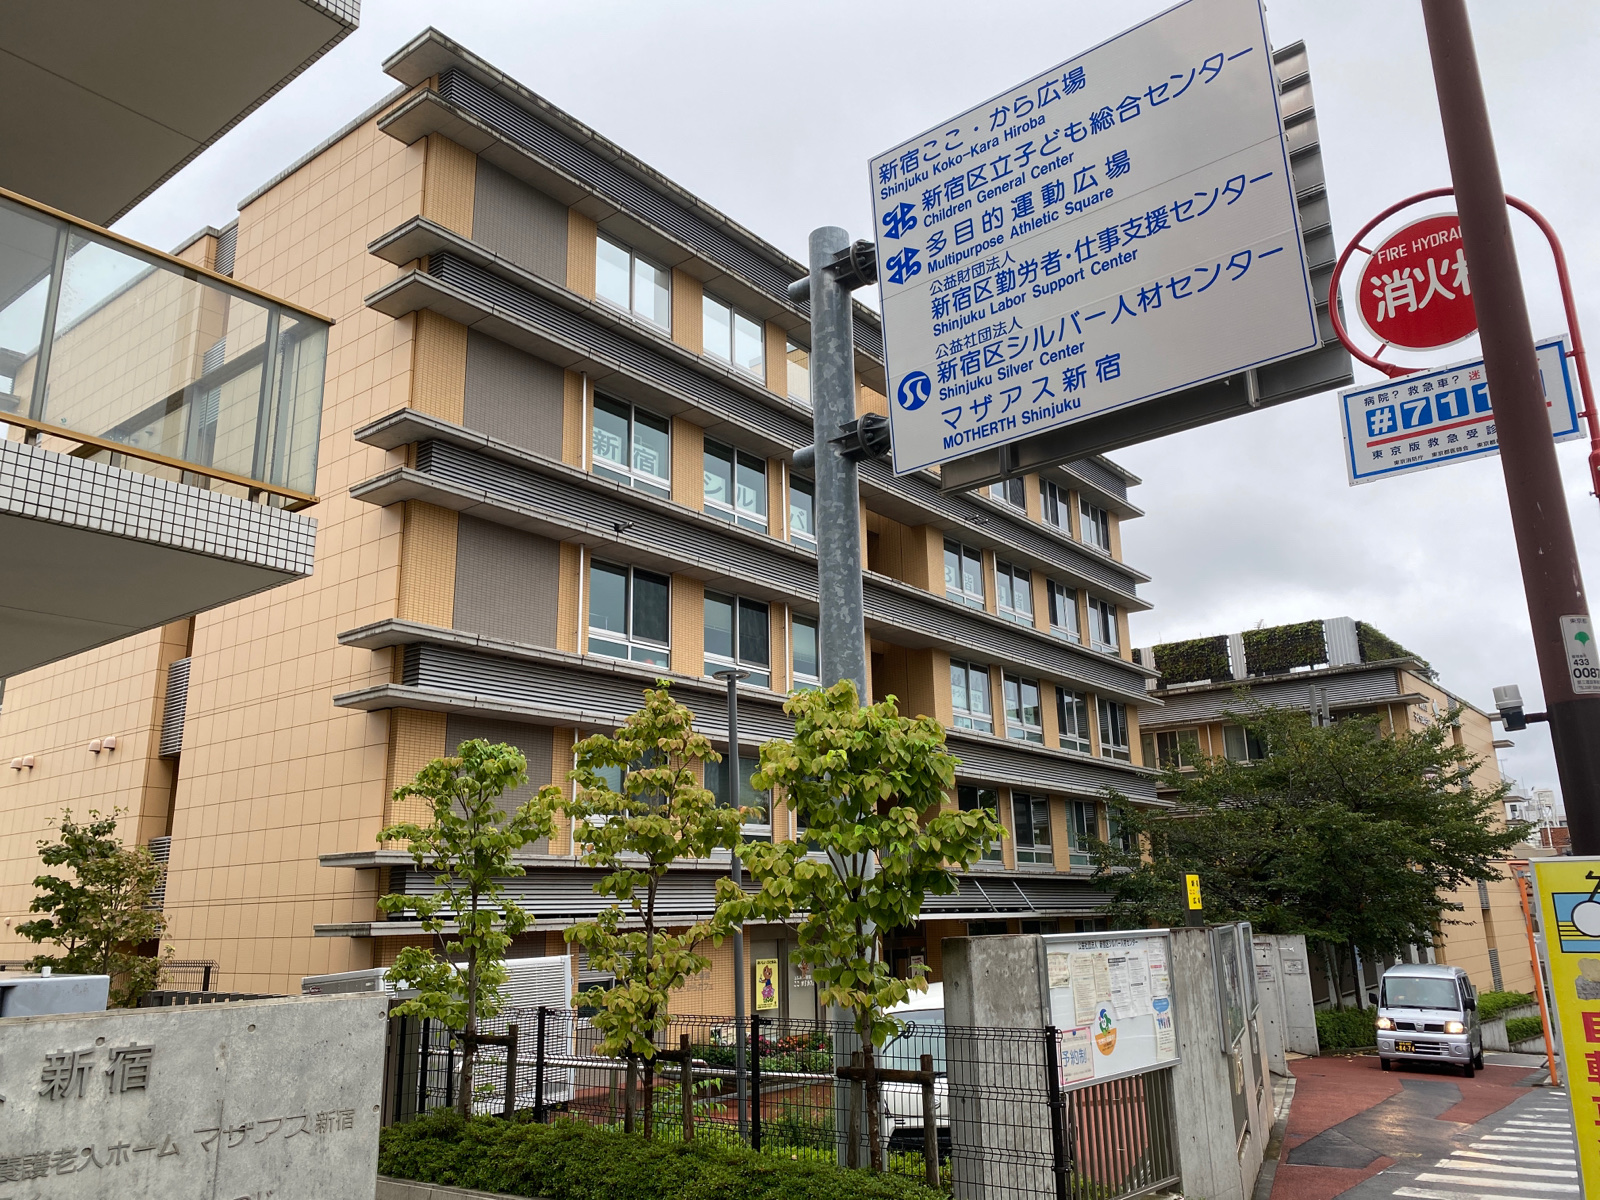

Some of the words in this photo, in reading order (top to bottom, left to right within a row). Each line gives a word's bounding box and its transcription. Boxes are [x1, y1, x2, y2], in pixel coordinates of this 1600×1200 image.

[878, 66, 1087, 186] 新宿ここ・から広場
[880, 170, 930, 200] Shinjuku
[931, 136, 1000, 177] Koko-Kara
[1003, 112, 1046, 144] Hiroba
[921, 47, 1253, 211] 新宿区立子ども総合センター
[923, 198, 973, 228] Children
[976, 172, 1027, 205] General
[1030, 150, 1075, 182] Center
[925, 149, 1131, 258] 多目的運動広場
[927, 231, 1005, 275] Multipurpose
[1009, 211, 1060, 242] Athletic
[1064, 185, 1114, 219] Square
[931, 172, 1273, 320] 新宿区勤労者・仕事支援センター
[1377, 243, 1408, 265] FIRE
[1412, 225, 1462, 254] HYDRA
[929, 251, 1016, 296] 公益財団法人
[933, 306, 986, 337] Shinjuku
[989, 291, 1027, 318] Labor
[1032, 267, 1086, 299] Support
[1090, 247, 1138, 277] Center
[935, 316, 1023, 360] 公益社団法人
[937, 246, 1284, 384] 新宿区シルバー人材センター
[938, 371, 992, 402] Shinjuku
[997, 357, 1034, 383] Silver
[1038, 340, 1085, 369] Center
[941, 353, 1122, 430] マザアス新宿
[1363, 389, 1400, 408] 病院？
[943, 416, 1018, 450] MOTHERTH
[1022, 395, 1082, 425] Shinjuku
[38, 1042, 155, 1100] 新宿
